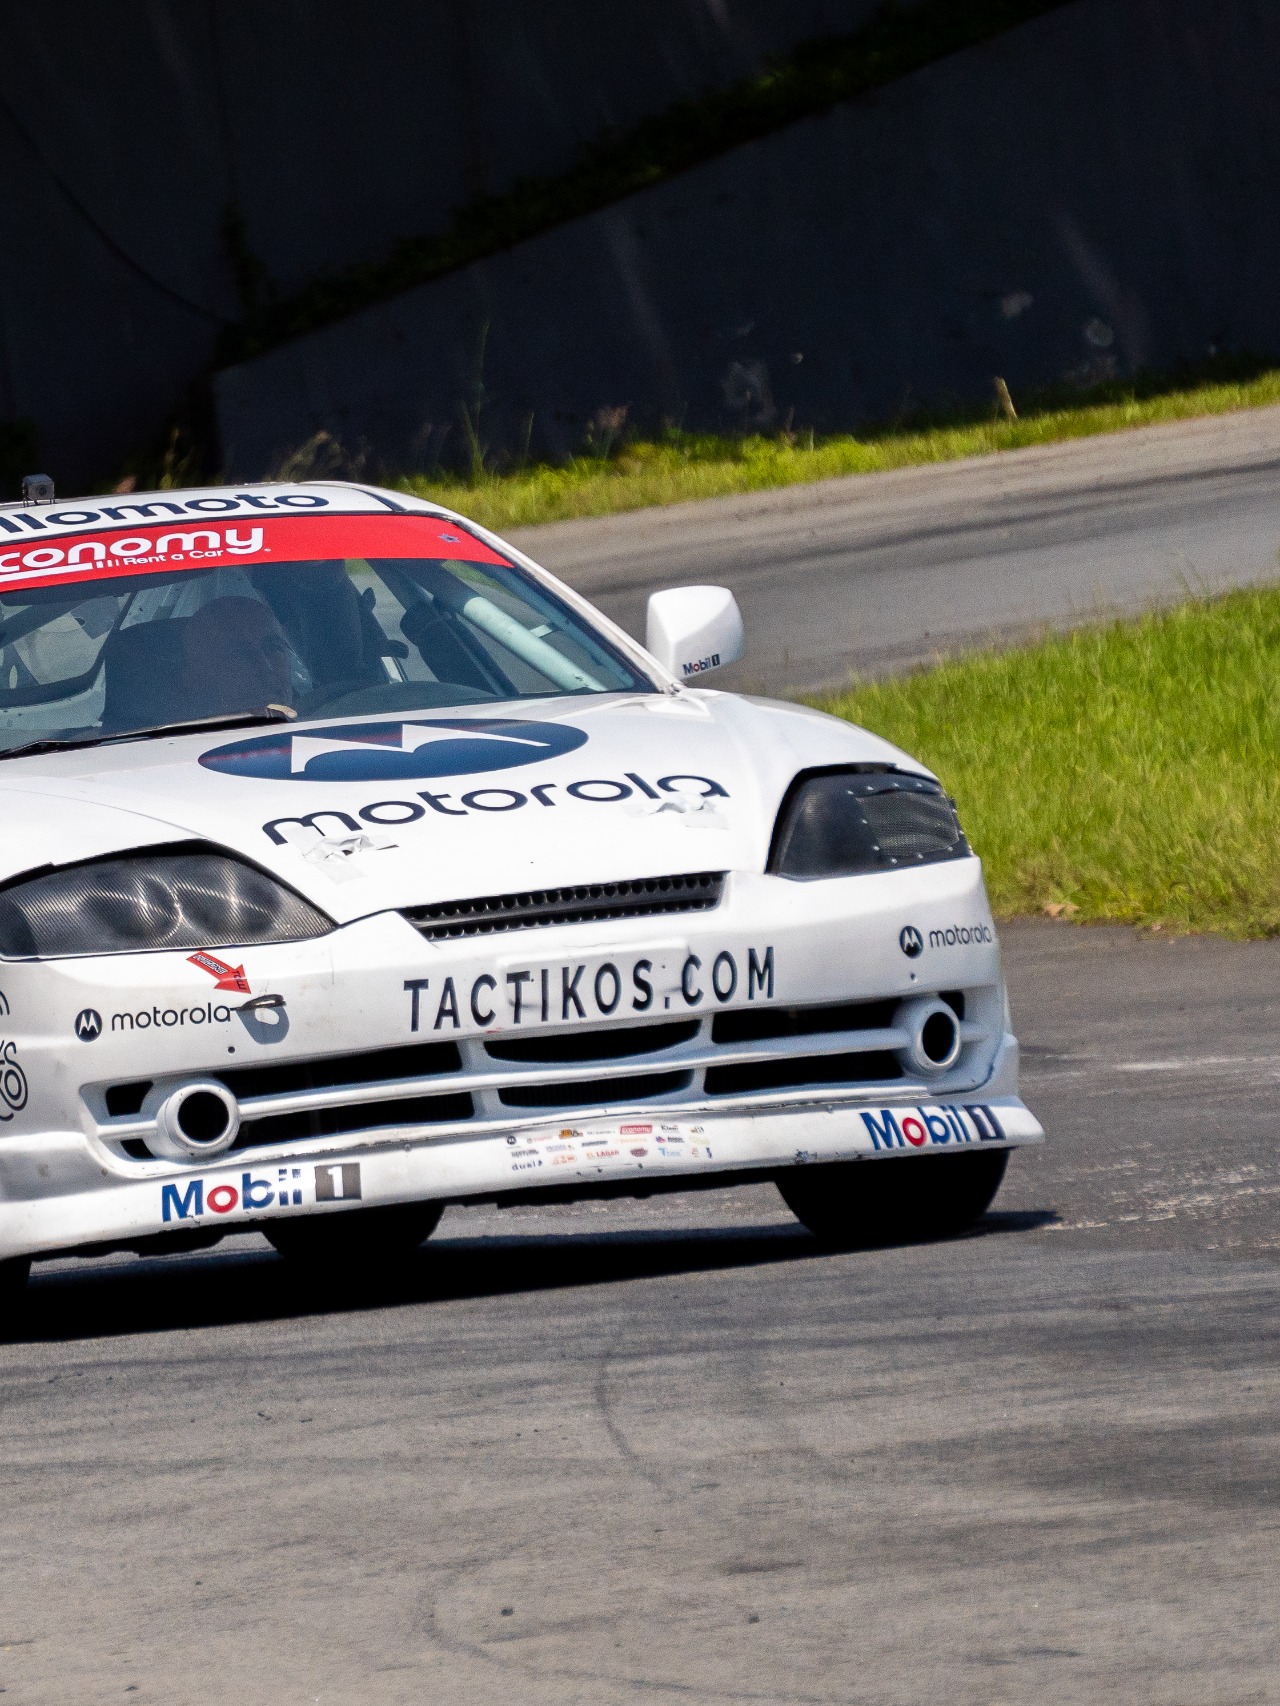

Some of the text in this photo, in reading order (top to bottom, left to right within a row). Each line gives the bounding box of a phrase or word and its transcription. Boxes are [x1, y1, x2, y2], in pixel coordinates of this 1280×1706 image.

[124, 553, 166, 565] Rent
[189, 549, 223, 559] Car
[682, 656, 711, 675] Mobil
[261, 773, 731, 846] motorola
[929, 922, 993, 948] motorola
[403, 946, 774, 1032] TACTIKOS.COM
[111, 1002, 231, 1031] motorola
[860, 1104, 1001, 1150] Mobil 1
[162, 1168, 302, 1222] Mobil
